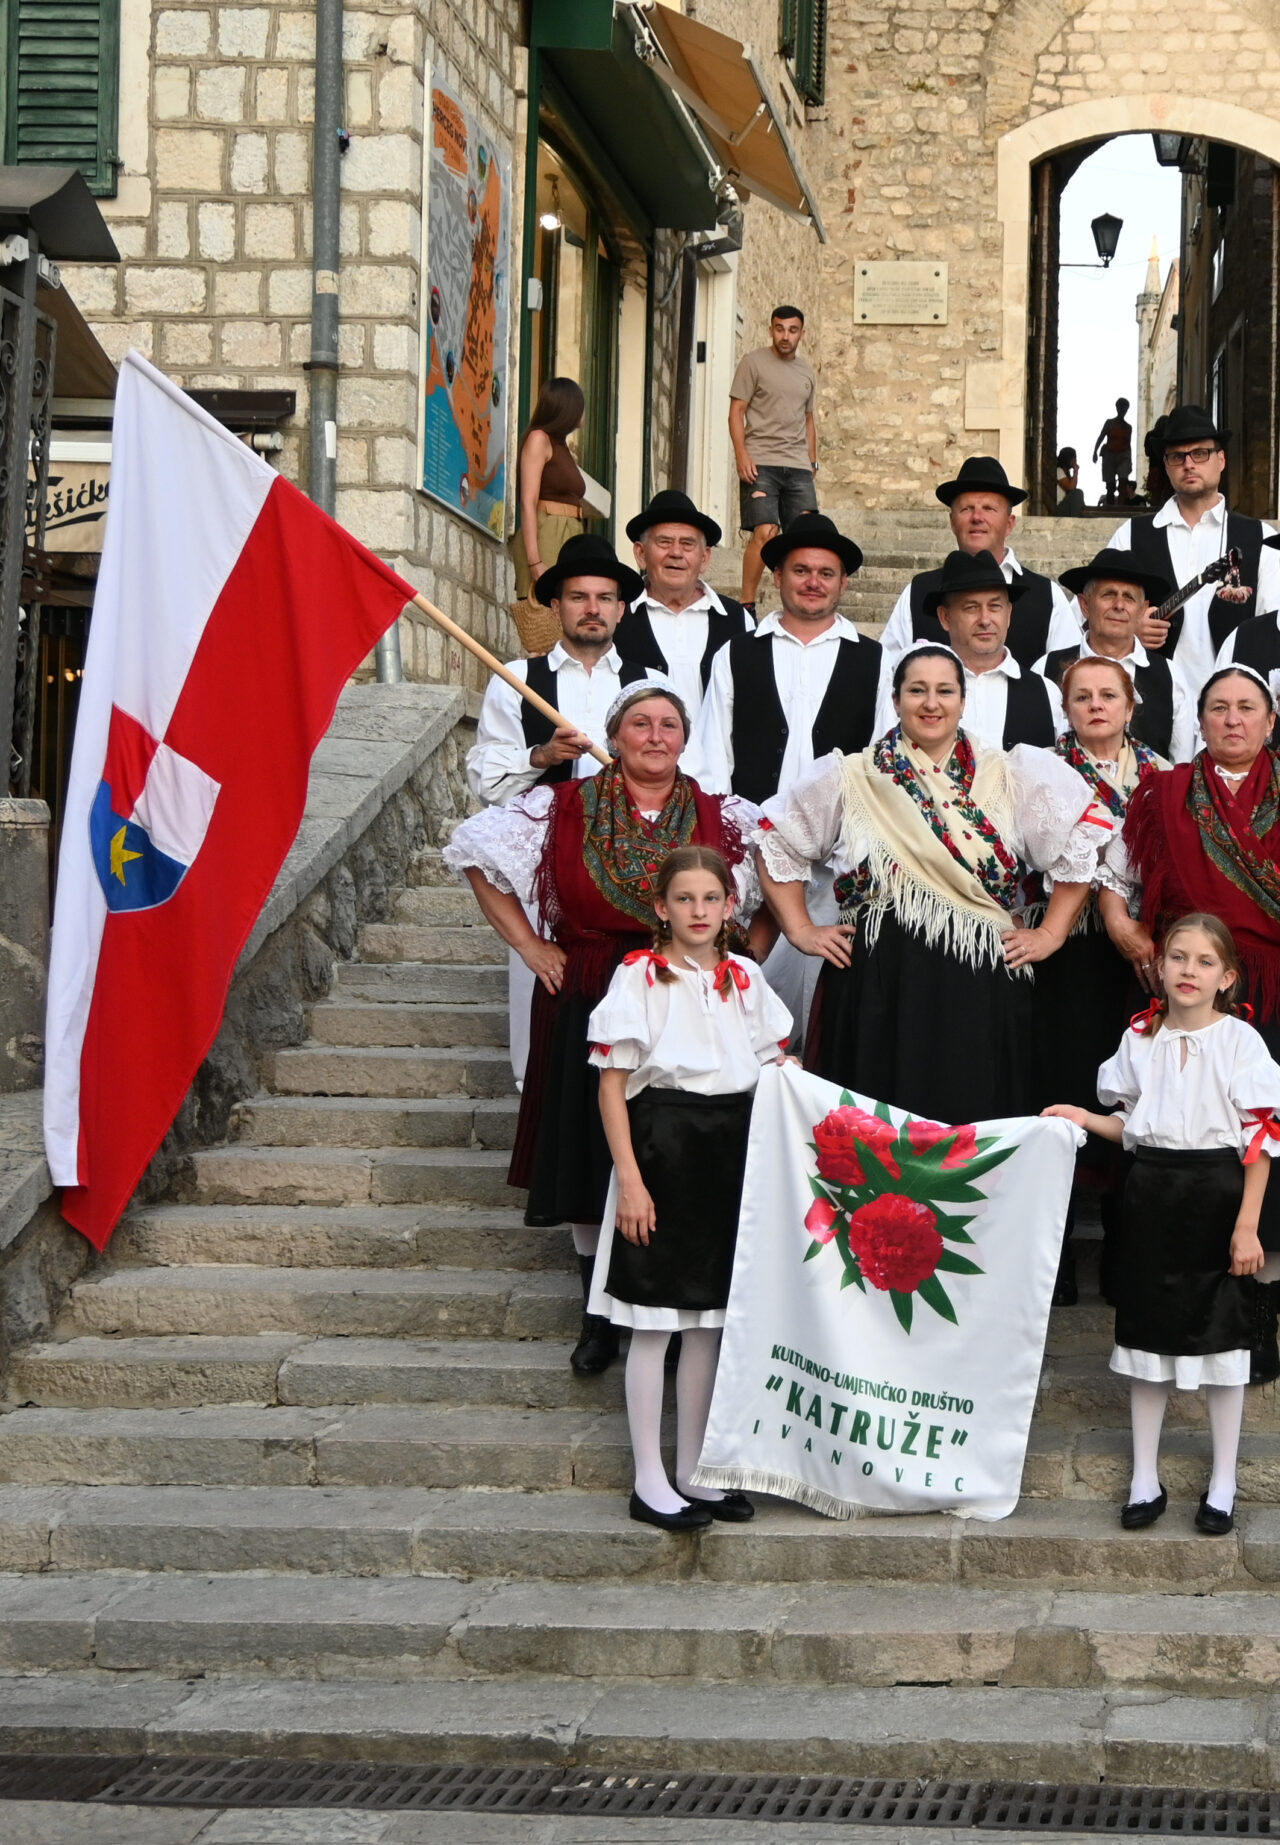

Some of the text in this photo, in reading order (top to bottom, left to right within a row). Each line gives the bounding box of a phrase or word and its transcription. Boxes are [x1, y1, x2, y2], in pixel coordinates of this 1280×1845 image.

[771, 1344, 974, 1415] KULTURNO-UMJETNIČKO DRUŠTVO
[753, 1419, 964, 1493] IVANOVEC
